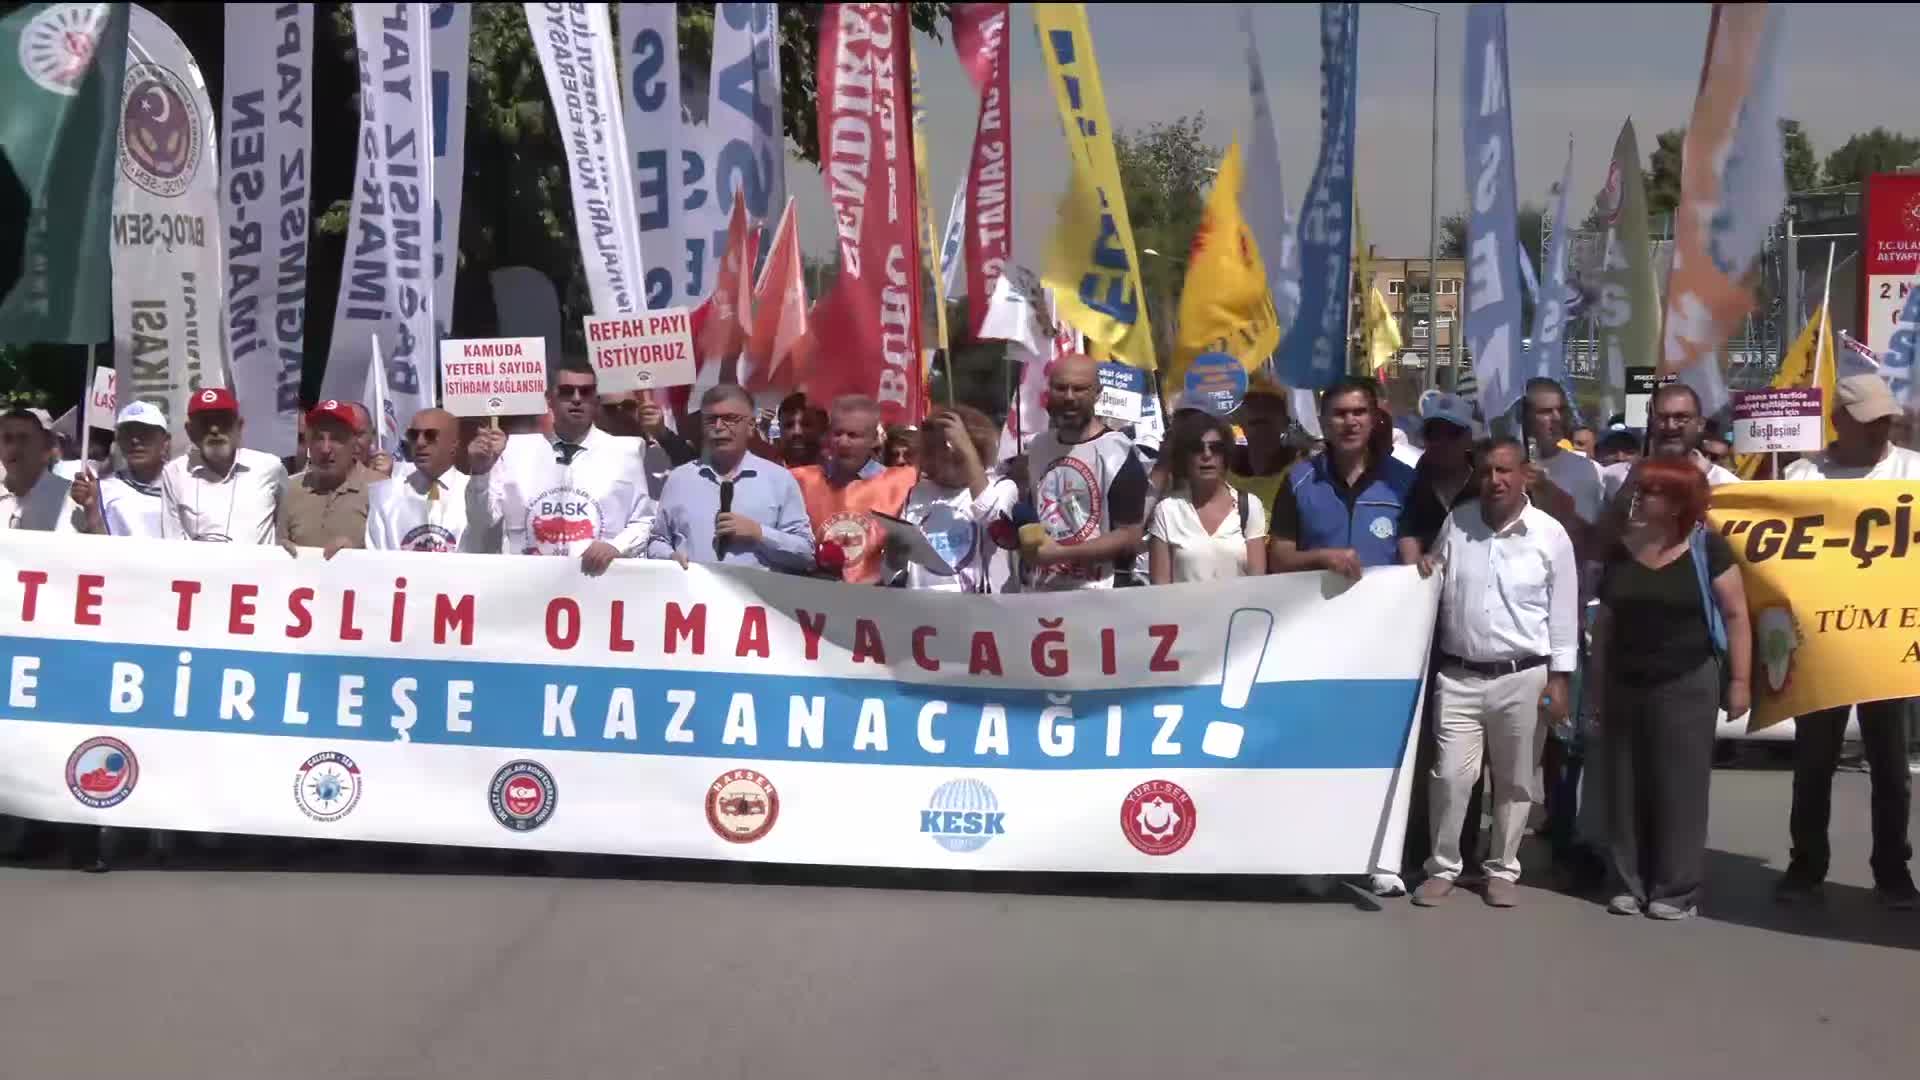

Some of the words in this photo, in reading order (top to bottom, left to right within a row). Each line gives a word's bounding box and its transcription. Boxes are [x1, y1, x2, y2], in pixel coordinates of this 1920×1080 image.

[589, 317, 645, 342] REFAH
[650, 314, 687, 334] PAYI
[463, 343, 523, 357] KAMUDA
[596, 342, 688, 369] İSTİYORUZ
[445, 363, 495, 376] YETERLİ
[498, 363, 543, 375] SAYIDA
[445, 379, 491, 395] İSTİHDAM
[492, 378, 544, 394] SAĞLANSIN
[541, 501, 589, 516] BASK
[171, 576, 476, 646] TESLİM
[545, 597, 1182, 678] OLMAYACAĞIZ
[1815, 603, 1888, 633] TÜM
[108, 650, 475, 743] BİRLEŞE
[712, 770, 774, 794] HAKSEN
[1126, 781, 1189, 803] YURT-SEN
[919, 809, 1006, 835] KESK
